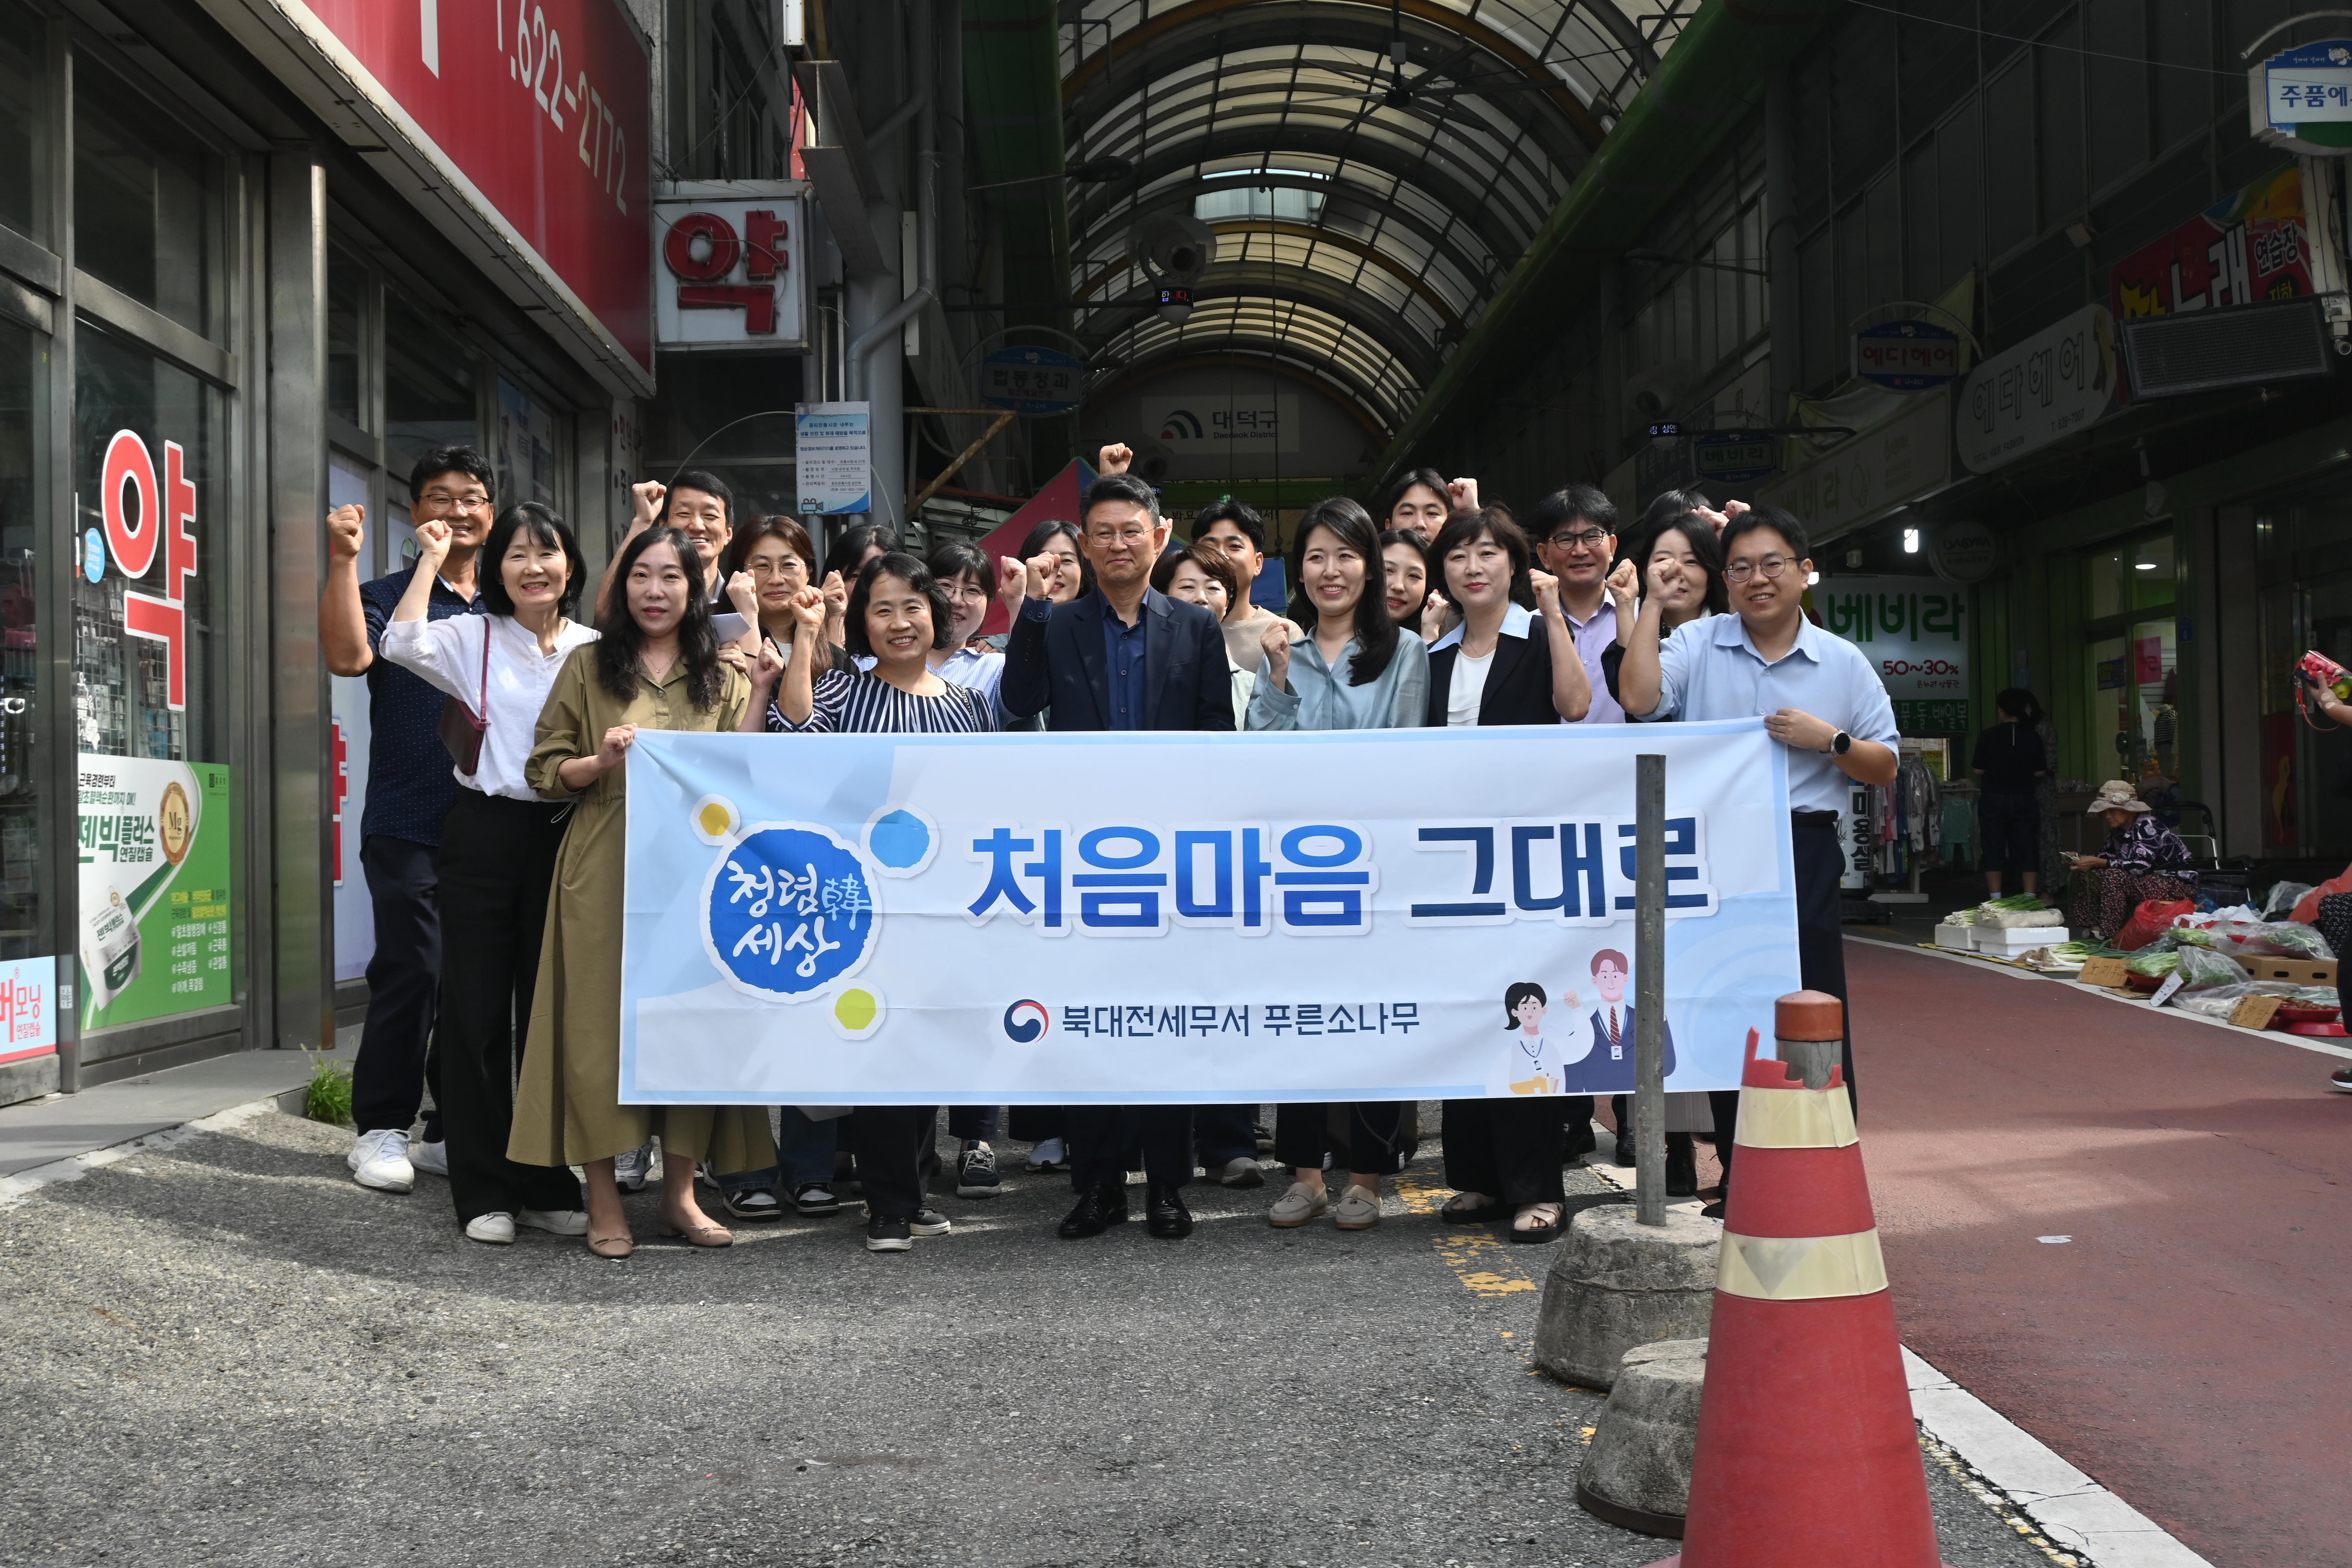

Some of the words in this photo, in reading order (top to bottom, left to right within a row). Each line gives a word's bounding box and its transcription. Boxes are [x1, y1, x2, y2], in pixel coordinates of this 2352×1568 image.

[2280, 85, 2352, 108] 주품에
[2255, 221, 2299, 276] 연습장
[663, 210, 789, 334] 약
[993, 369, 1070, 390] 법동청과
[1213, 410, 1279, 429] 대덕구
[1705, 446, 1764, 463] 베비라
[101, 429, 197, 712] 약
[1828, 593, 1965, 642] 베비라
[1883, 659, 1959, 676] 50~30%
[1939, 680, 1960, 689] 상품권
[79, 773, 116, 789] 근육경련부터
[127, 792, 136, 806] OK!
[121, 815, 155, 845] 플러스
[169, 812, 182, 835] Mg
[120, 847, 153, 863] 연질캡슐
[966, 825, 1370, 928] 처음마음
[1410, 817, 1709, 918] 그대로
[732, 915, 841, 977] 세상
[16, 984, 41, 1019] 모닝
[16, 1021, 41, 1040] 연질캡슐
[1062, 1005, 1250, 1038] 북대전세무서
[1263, 1002, 1420, 1036] 푸른소나무
